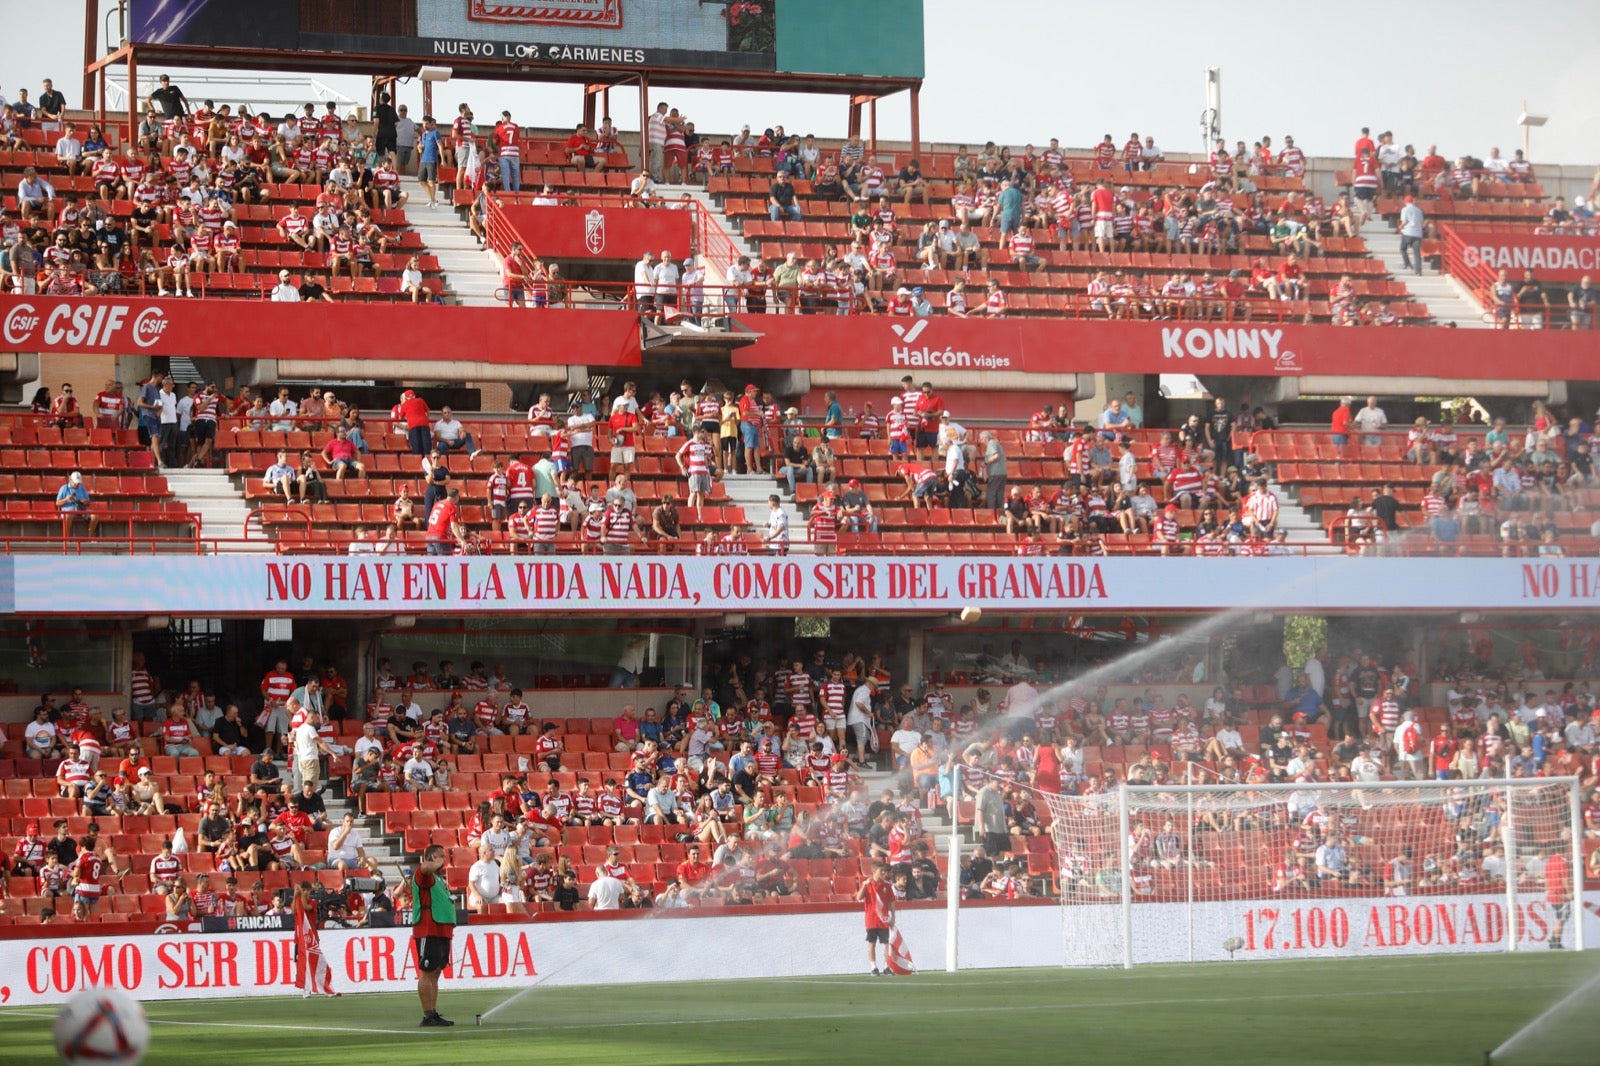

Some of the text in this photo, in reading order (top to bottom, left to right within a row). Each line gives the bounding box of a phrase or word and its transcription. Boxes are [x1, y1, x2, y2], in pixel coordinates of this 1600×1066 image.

[434, 41, 494, 56] NUEVO
[505, 44, 539, 58] LOS
[506, 130, 515, 145] 7
[11, 316, 39, 330] CSIF
[44, 303, 130, 346] CSIF
[139, 319, 168, 334] CSIF
[1161, 327, 1283, 359] KONNY
[892, 346, 1010, 368] Halcón viajes
[517, 472, 527, 488] 4
[266, 562, 1108, 605] NO HAY EN LA VIDA NADA, COMO SER DEL GRANADA
[1521, 563, 1559, 599] NO
[92, 862, 101, 880] 8
[227, 915, 282, 930] #FANCAM
[1243, 900, 1549, 952] 17.100 ABONADOS
[26, 931, 538, 994] COMO SER DE GRAADA
